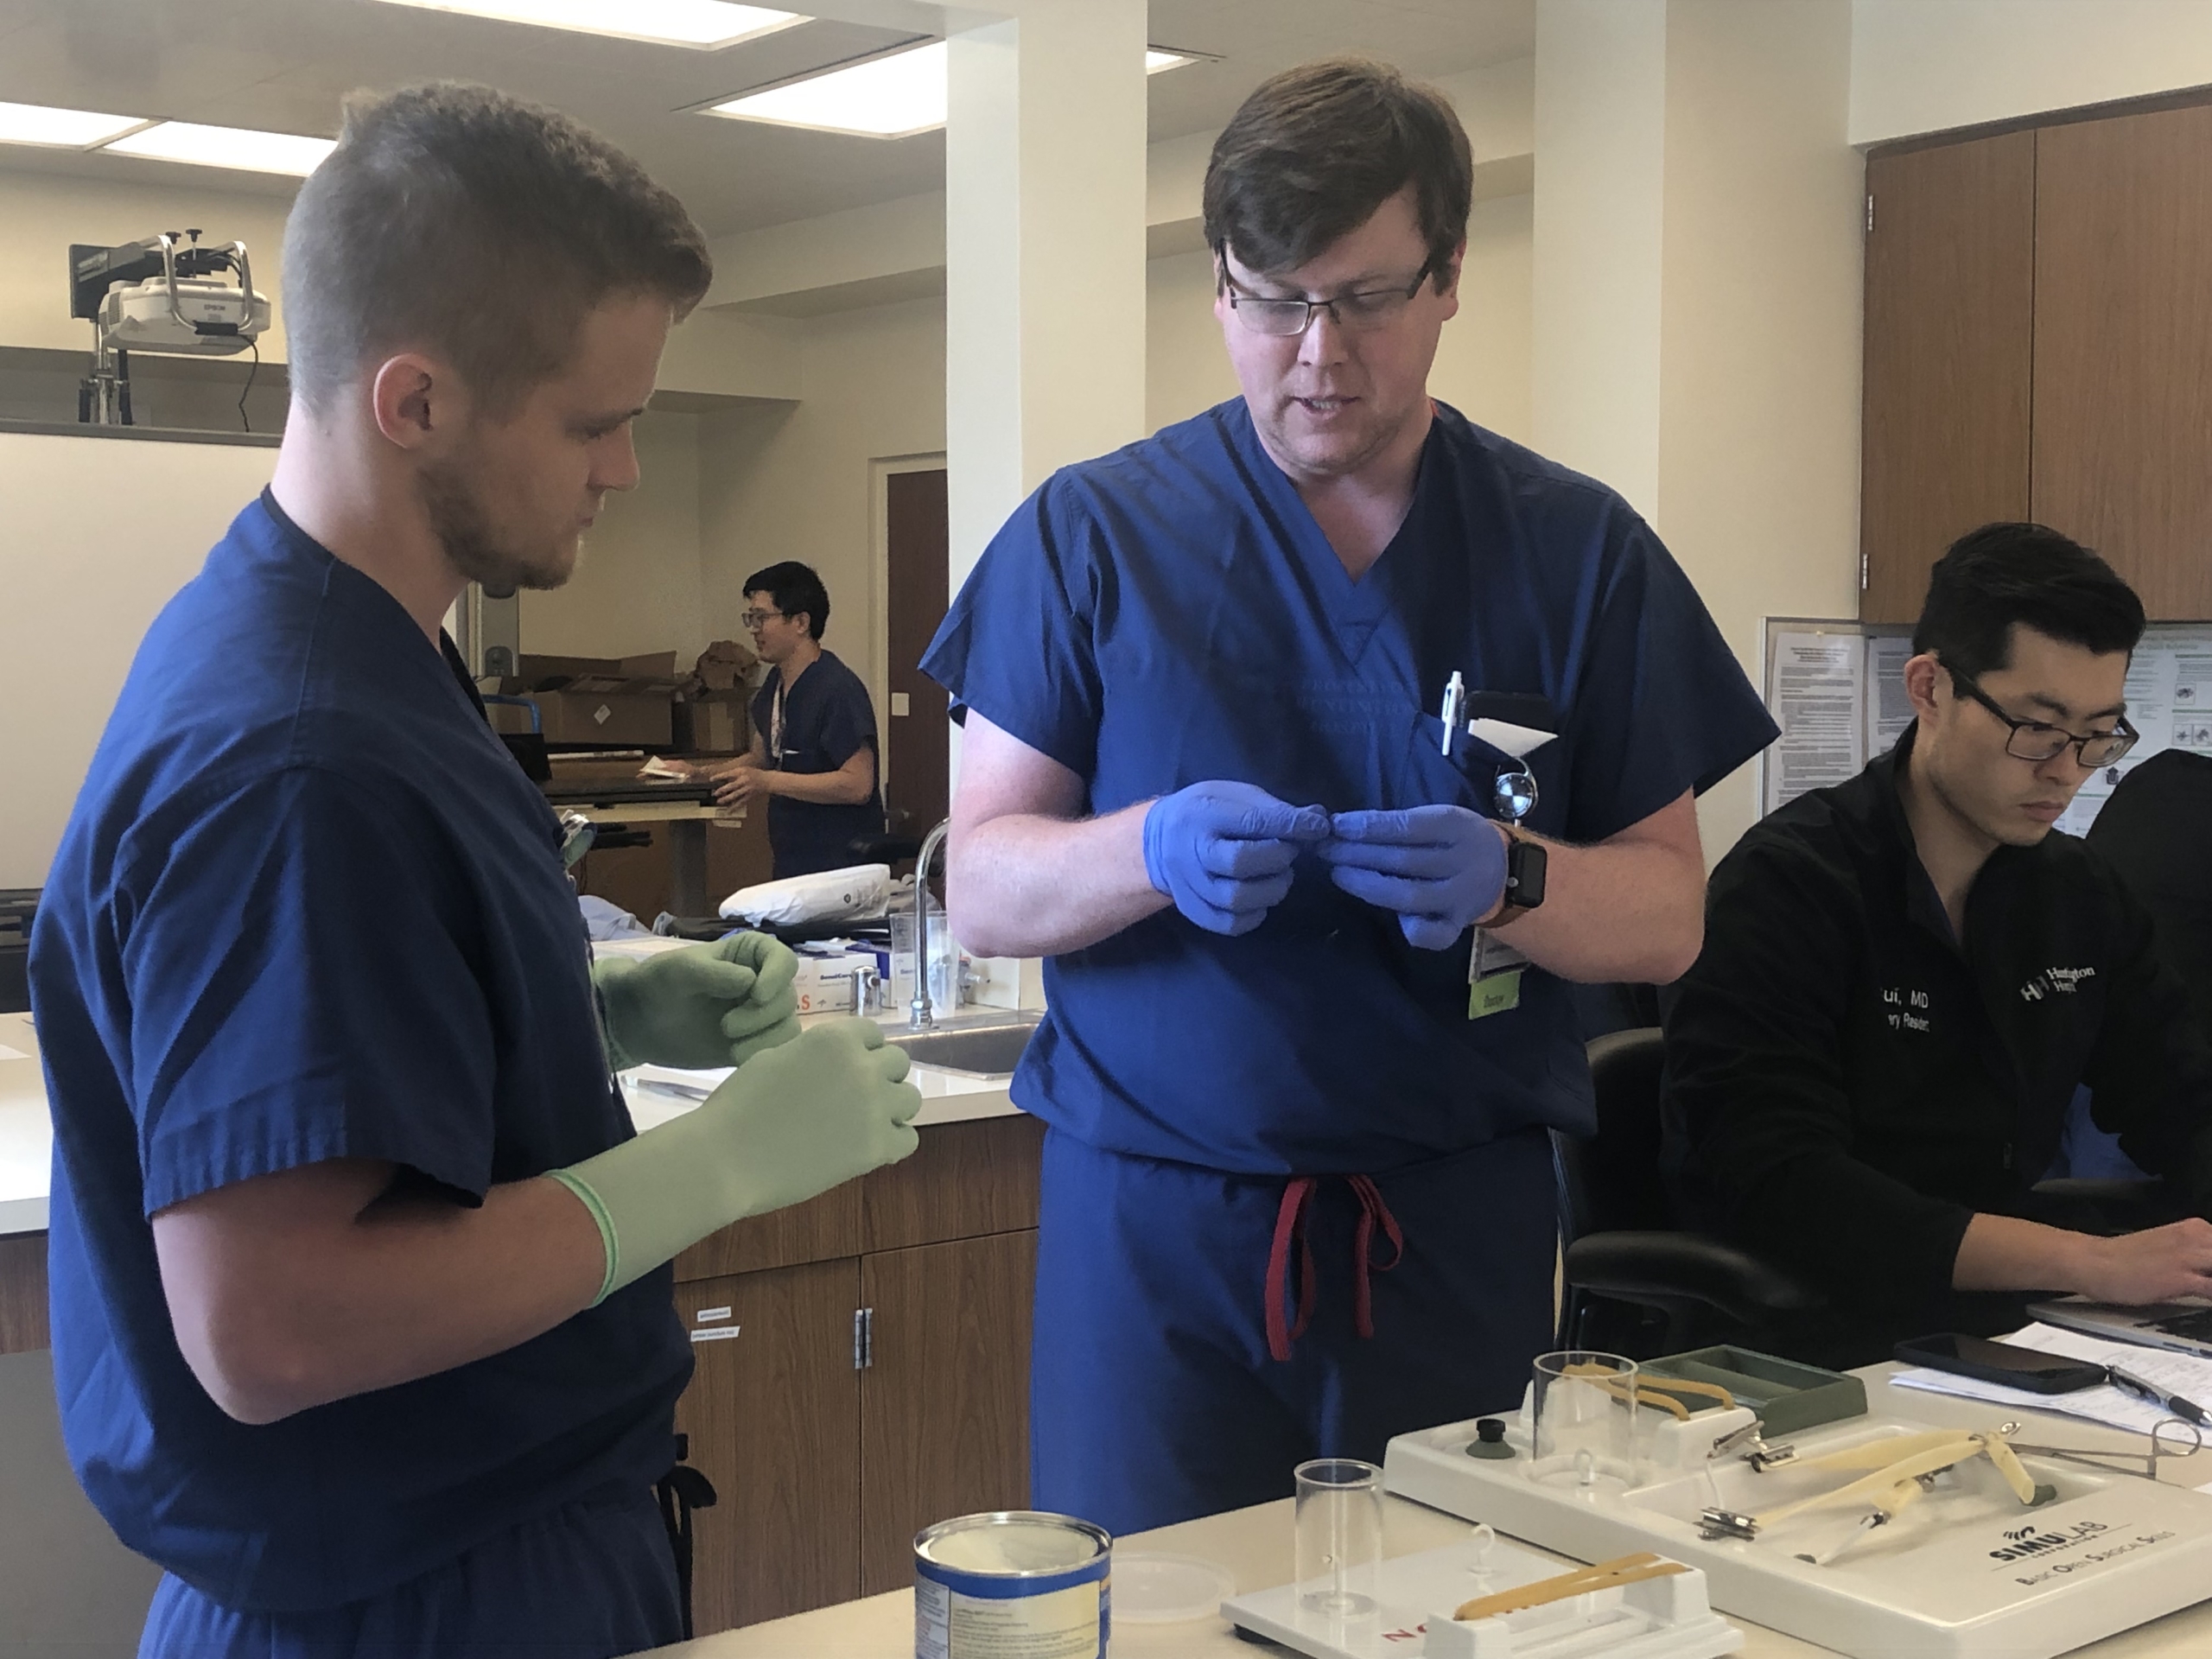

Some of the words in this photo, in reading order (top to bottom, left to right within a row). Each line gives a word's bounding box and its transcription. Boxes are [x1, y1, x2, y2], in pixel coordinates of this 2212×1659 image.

[1883, 987, 1903, 1007] ui,
[1910, 989, 1929, 1008] MD
[1989, 1521, 2108, 1561] SIMULAB
